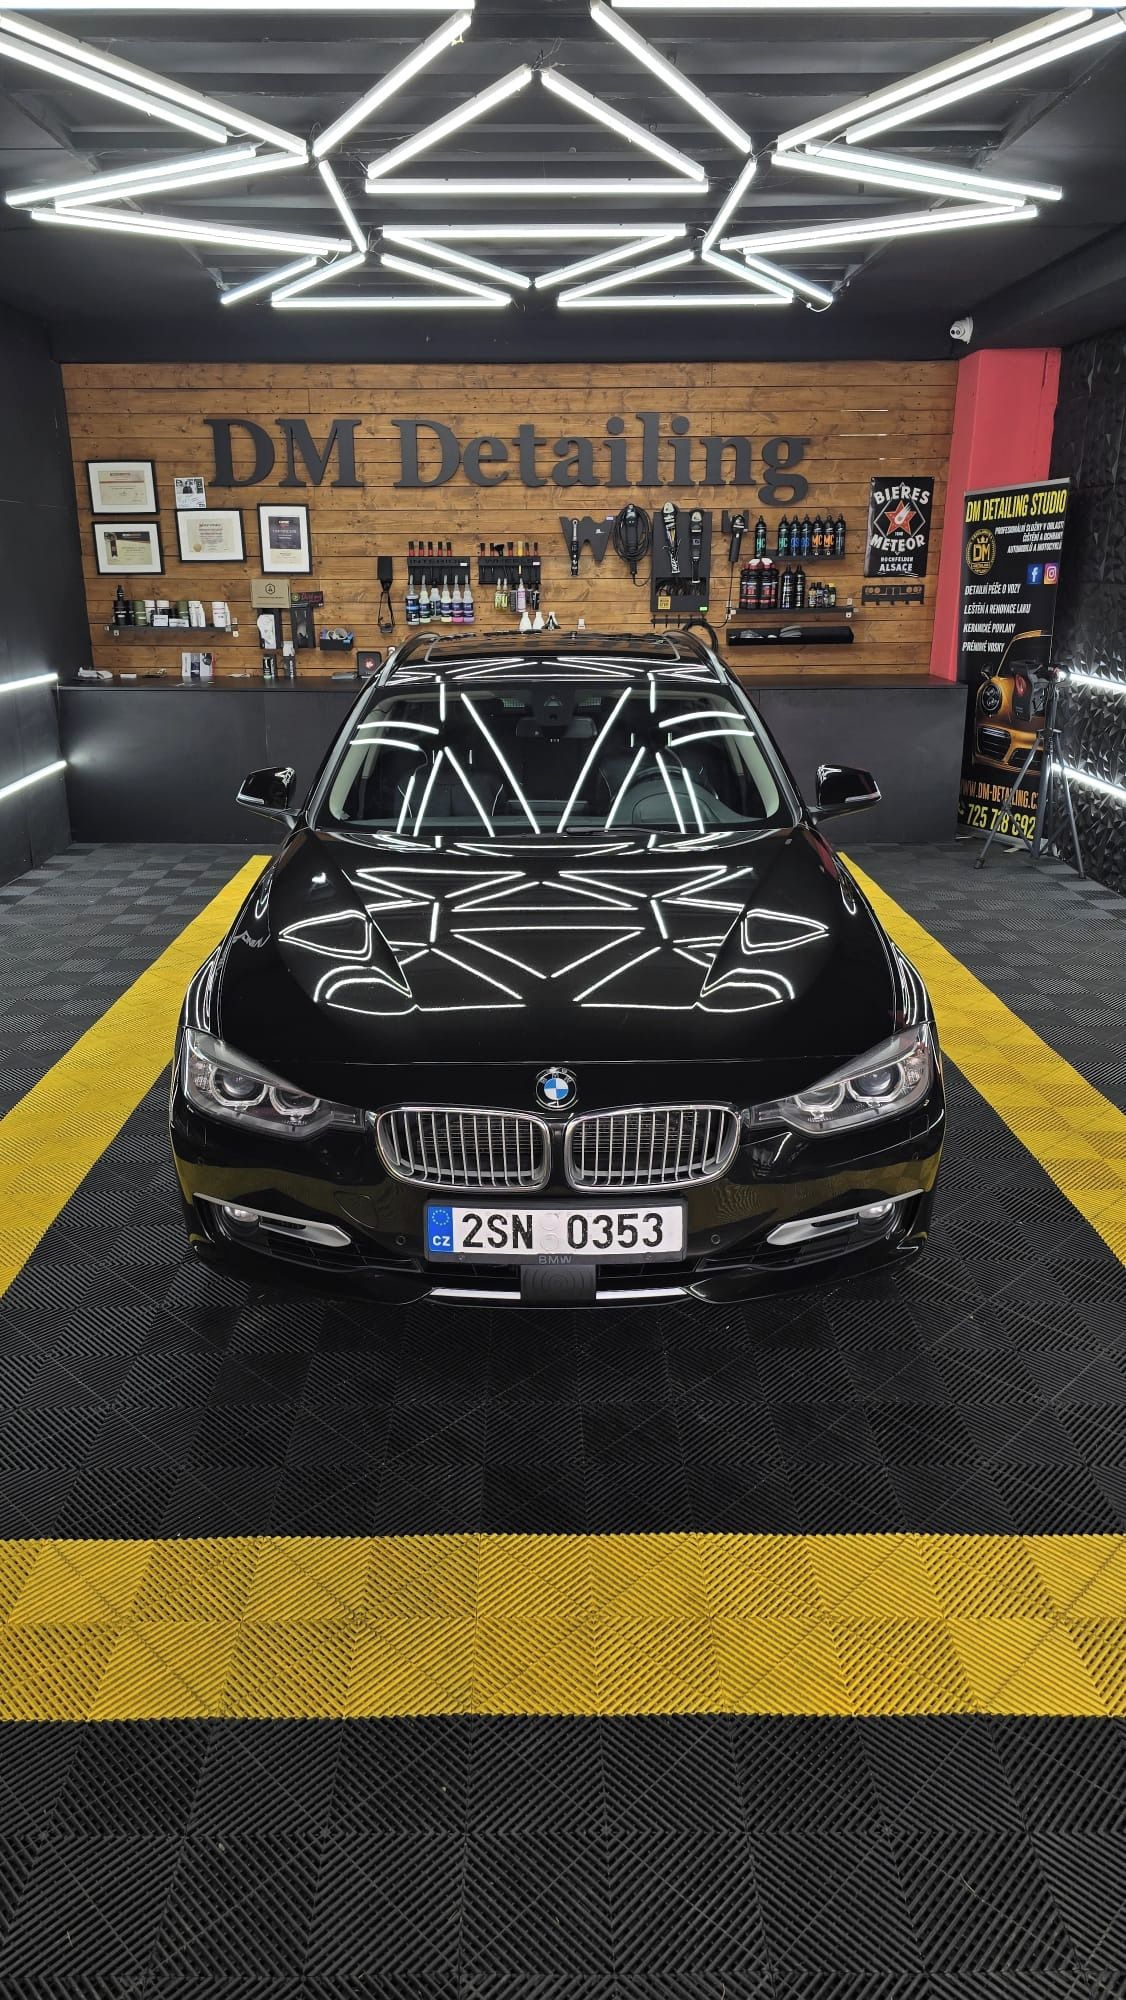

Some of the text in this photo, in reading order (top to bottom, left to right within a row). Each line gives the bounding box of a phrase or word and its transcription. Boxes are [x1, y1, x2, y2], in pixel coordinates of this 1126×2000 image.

[203, 412, 812, 507] DM Detailing
[873, 486, 931, 505] BIERES
[965, 490, 1067, 523] DM DETAILING STUDIO
[870, 534, 926, 552] METEOR
[973, 543, 990, 561] DM
[879, 563, 913, 572] ALSACE
[967, 803, 988, 828] 725
[462, 1212, 664, 1250] 2SN 0353
[432, 1235, 451, 1247] CZ
[538, 1255, 572, 1265] BMW
